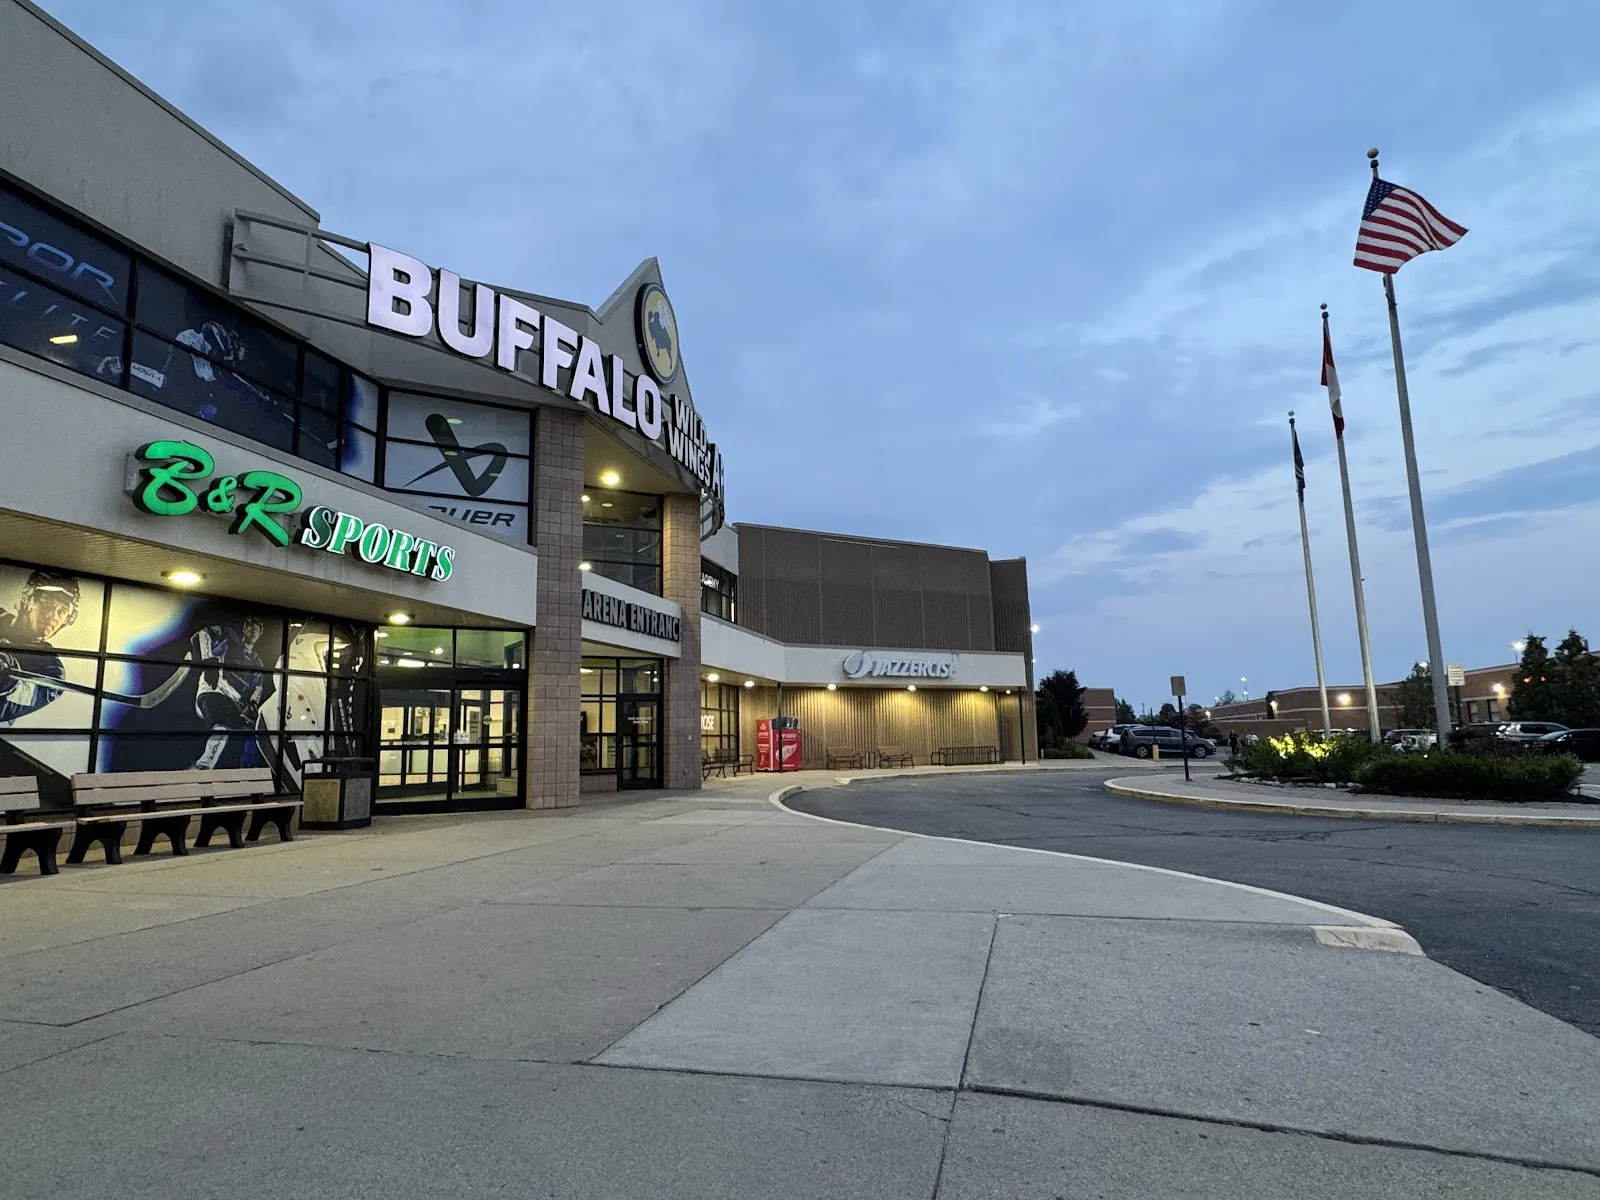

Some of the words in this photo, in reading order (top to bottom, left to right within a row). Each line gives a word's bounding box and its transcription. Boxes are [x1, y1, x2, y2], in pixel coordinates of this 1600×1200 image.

[367, 242, 661, 440] BUFFALO
[664, 421, 711, 487] WINGS
[671, 394, 707, 452] WILD
[301, 504, 456, 582] SPORTS
[582, 588, 627, 630] ARENA
[627, 603, 681, 641] ENTRANC
